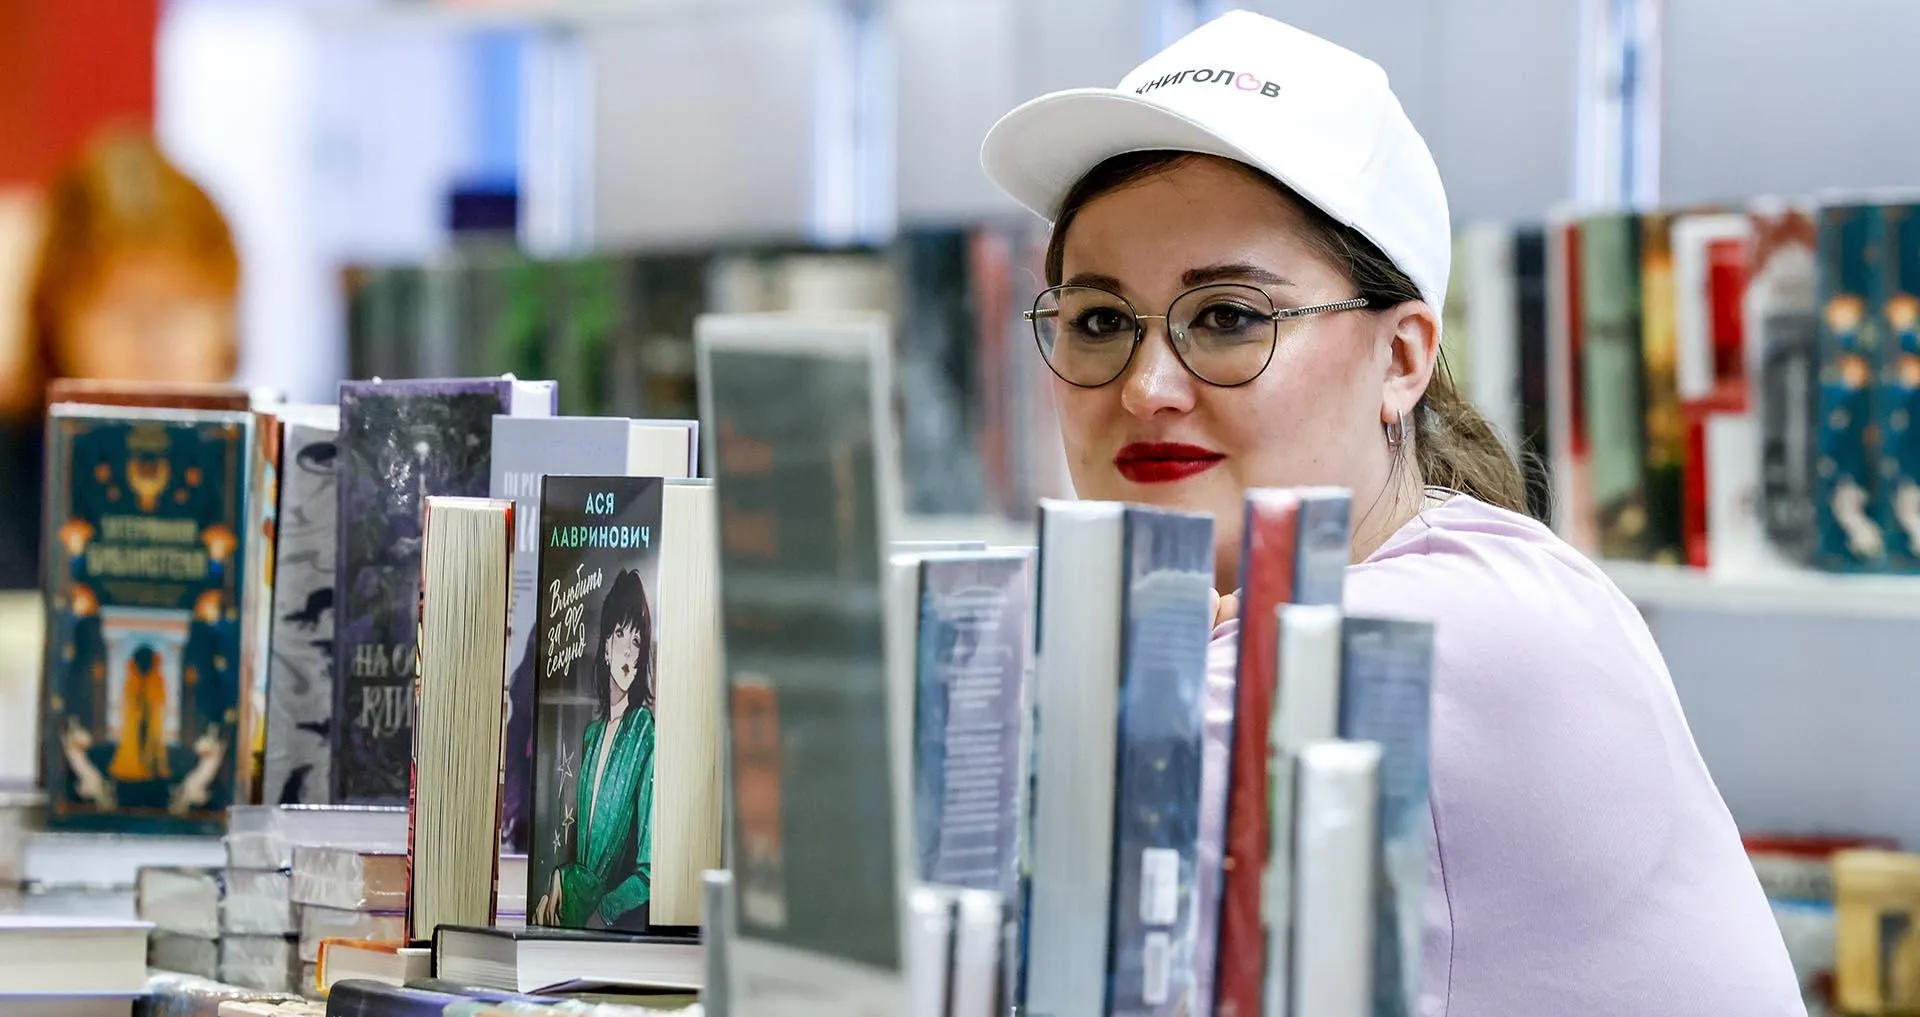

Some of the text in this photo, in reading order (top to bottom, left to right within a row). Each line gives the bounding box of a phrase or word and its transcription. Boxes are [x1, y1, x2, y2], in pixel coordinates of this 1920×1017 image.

[584, 491, 615, 515] АСЯ
[550, 525, 650, 549] ЛАВРИНОВИЧ
[549, 562, 603, 619] Влюбить
[546, 621, 587, 678] секунд
[547, 620, 562, 657] за
[354, 642, 390, 677] НА
